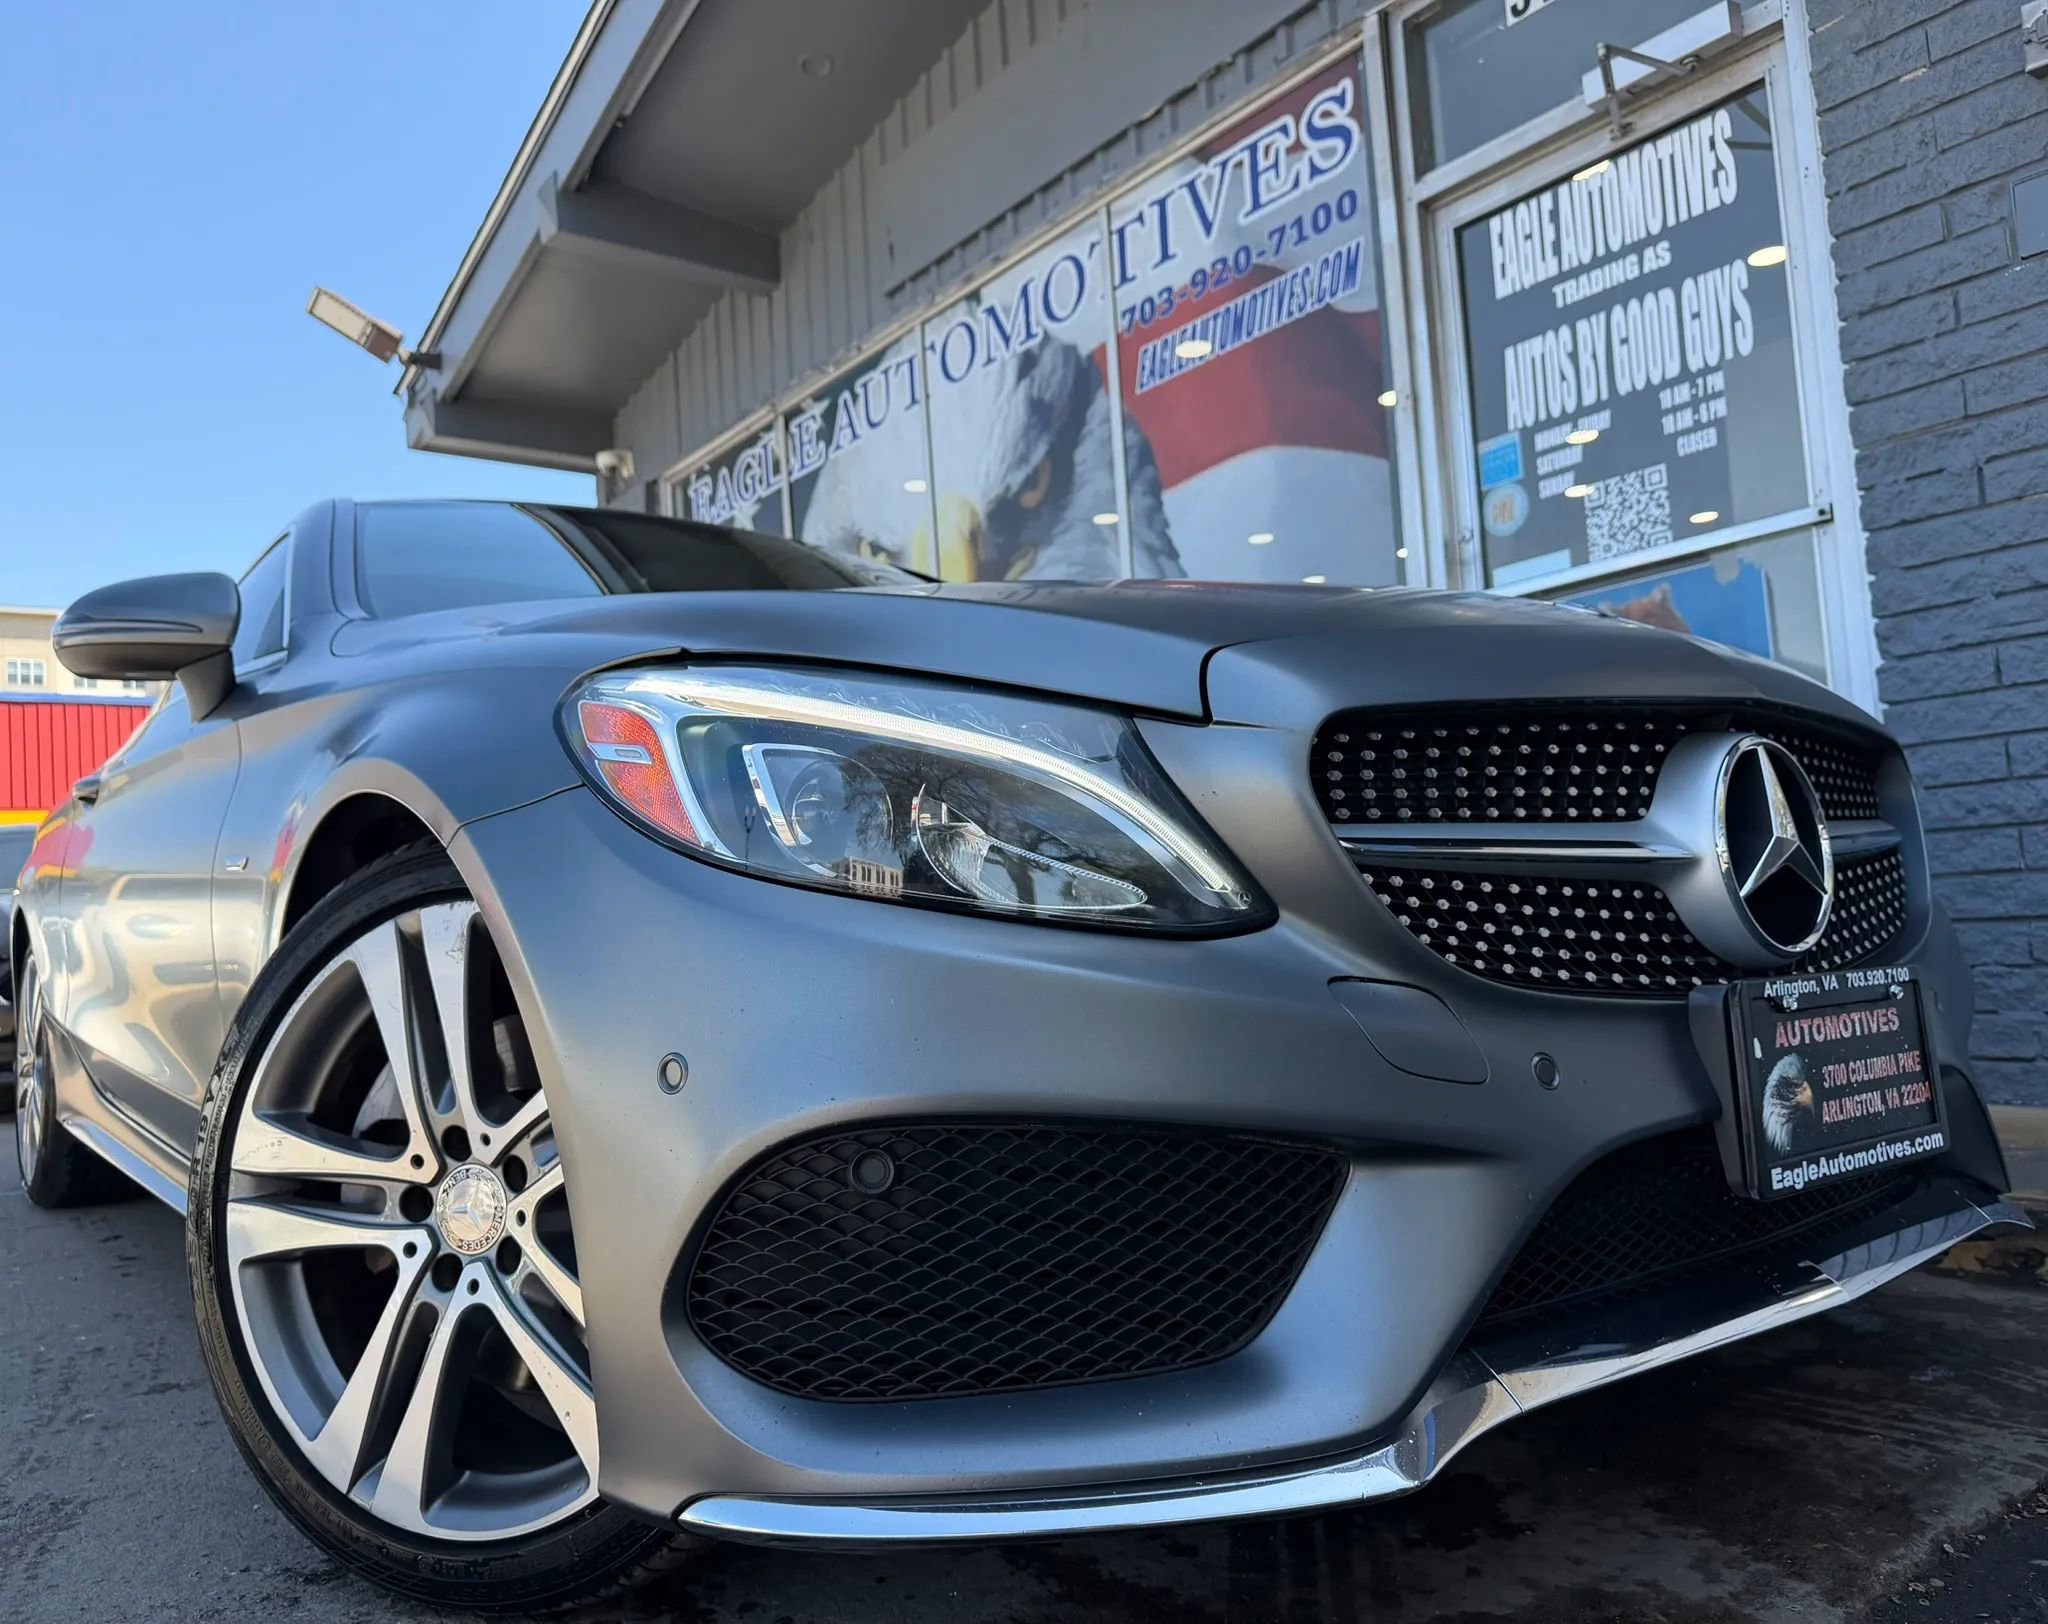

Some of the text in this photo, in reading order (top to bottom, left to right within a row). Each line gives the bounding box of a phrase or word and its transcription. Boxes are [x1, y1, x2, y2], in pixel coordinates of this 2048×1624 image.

[1489, 108, 1738, 299] EAGLE AUTOMOTIVES
[1121, 188, 1358, 337] 703-920-7100
[1552, 240, 1673, 308] TRADING AS
[688, 79, 1359, 524] EAGLE AUTOMOTIVES
[1136, 237, 1364, 393] EAGLEAUTOMOTIVES.COM
[1504, 258, 1754, 432] AUTOS BY GOOD GUYS
[1705, 370, 1725, 394] PM
[1708, 396, 1727, 421] PM
[1764, 966, 1910, 998] Arlington, VA 703.920.7100
[1775, 1006, 1900, 1048] AUTOMOTIVES
[1822, 1050, 1922, 1089] 3700 COLUMBIA PIKE
[1822, 1080, 1932, 1124] ARLINGTON, VA 22204
[1771, 1131, 1945, 1190] EagleAutomotives.com
[462, 1208, 503, 1251] MERCEDES
